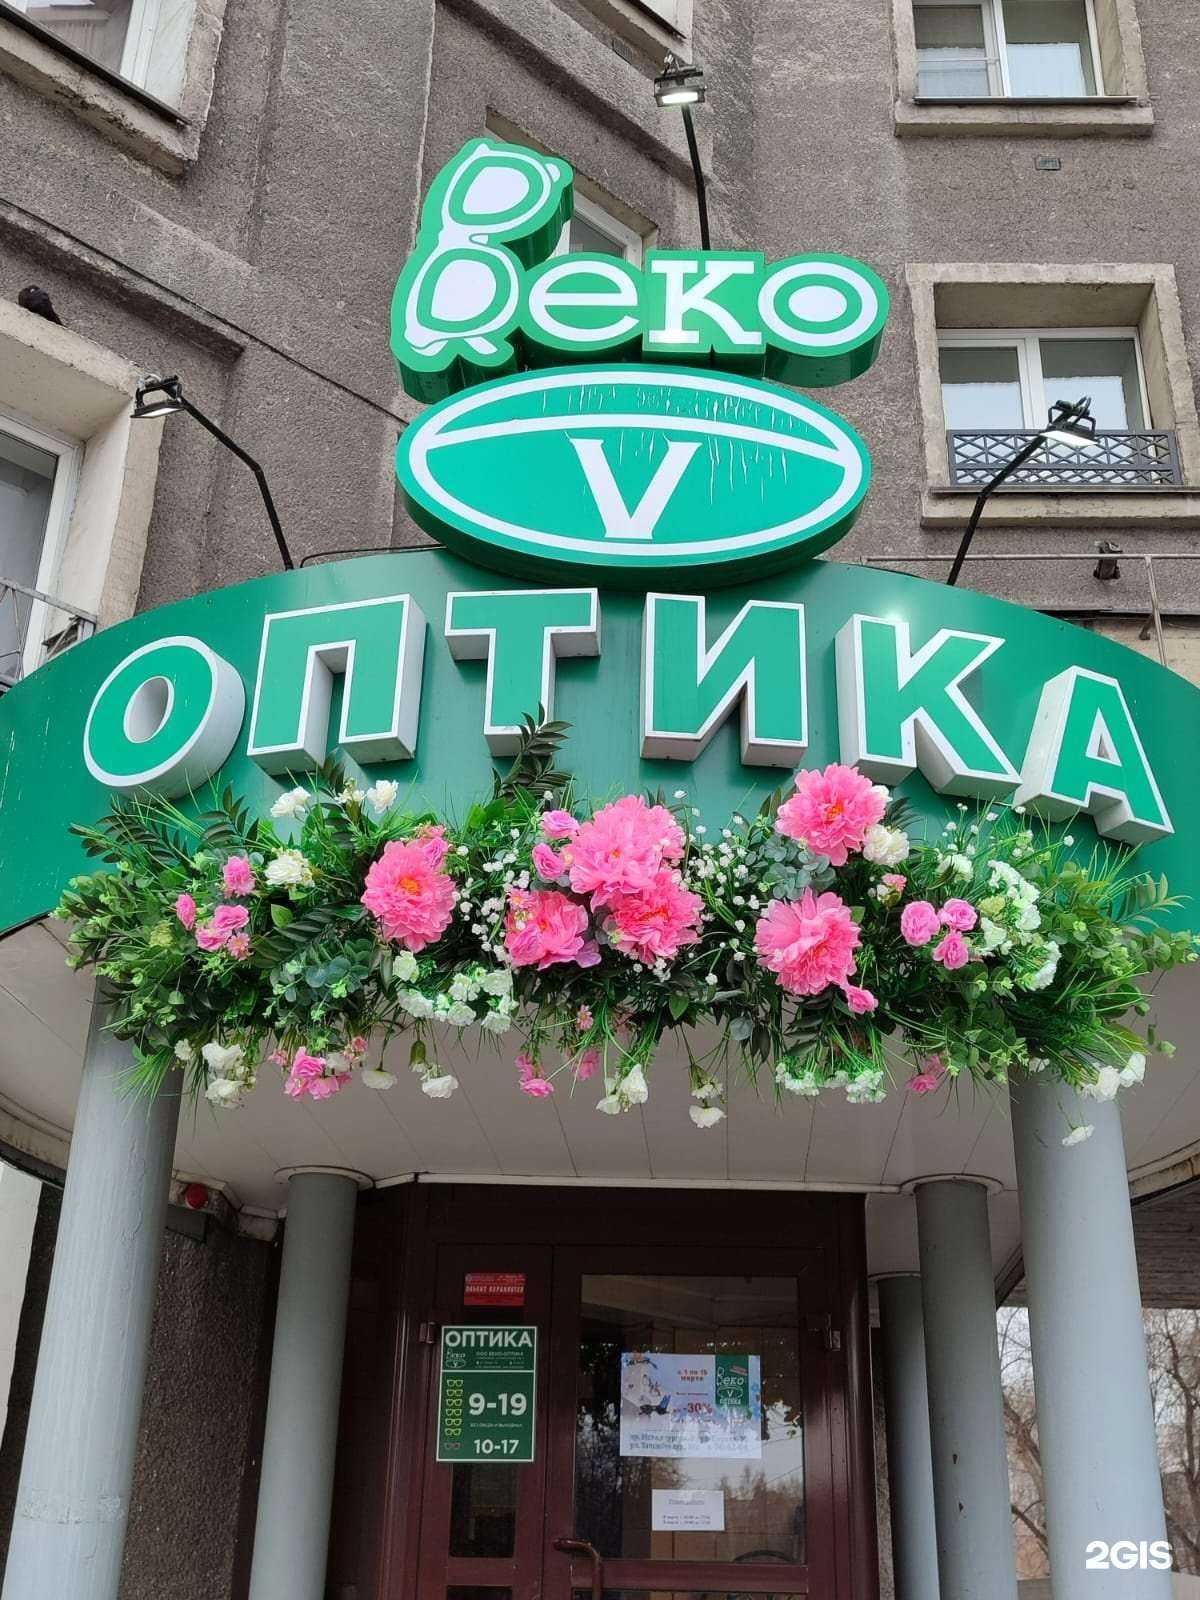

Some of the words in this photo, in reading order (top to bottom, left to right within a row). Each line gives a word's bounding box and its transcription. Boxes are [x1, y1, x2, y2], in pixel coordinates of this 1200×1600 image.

[567, 436, 704, 540] V
[82, 586, 1174, 844] ОПТИКА
[445, 1330, 533, 1347] ОПТИКА
[468, 1393, 528, 1416] 9-19
[473, 1439, 520, 1455] 10-17
